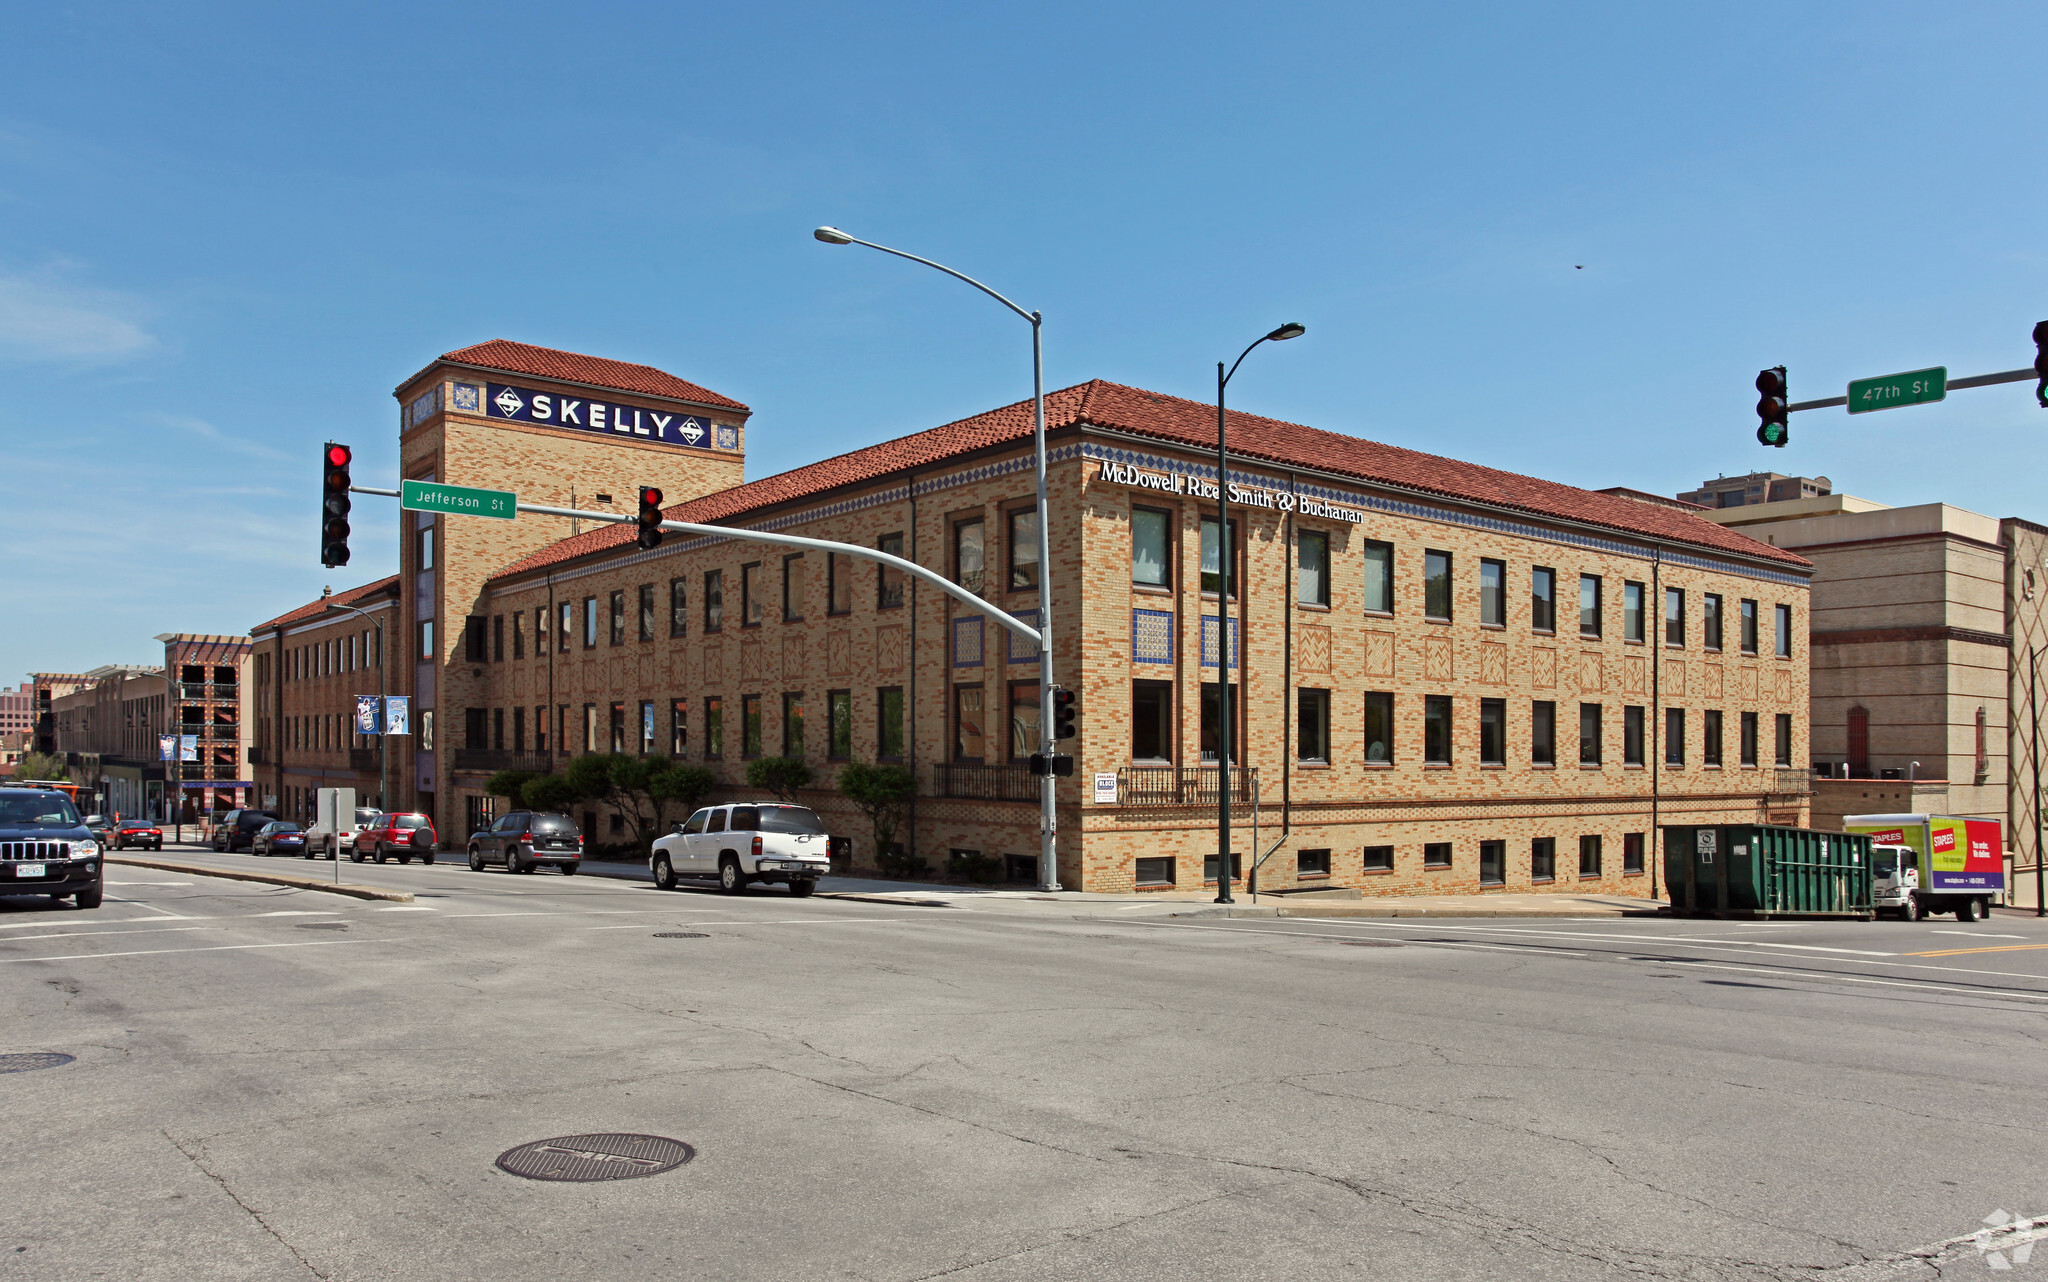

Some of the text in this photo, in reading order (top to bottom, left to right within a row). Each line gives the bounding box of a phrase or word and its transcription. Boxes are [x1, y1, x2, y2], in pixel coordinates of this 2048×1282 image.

[1862, 380, 1929, 401] 47th St
[531, 395, 673, 438] SKELLY
[416, 490, 504, 511] Jefferson St
[1100, 461, 1182, 495] McDowell,
[1187, 476, 1220, 499] Rice
[1276, 492, 1295, 511] &
[1299, 495, 1364, 524] Buchanan
[1872, 833, 1902, 842] TAPLES
[1933, 833, 1954, 847] STAPLES
